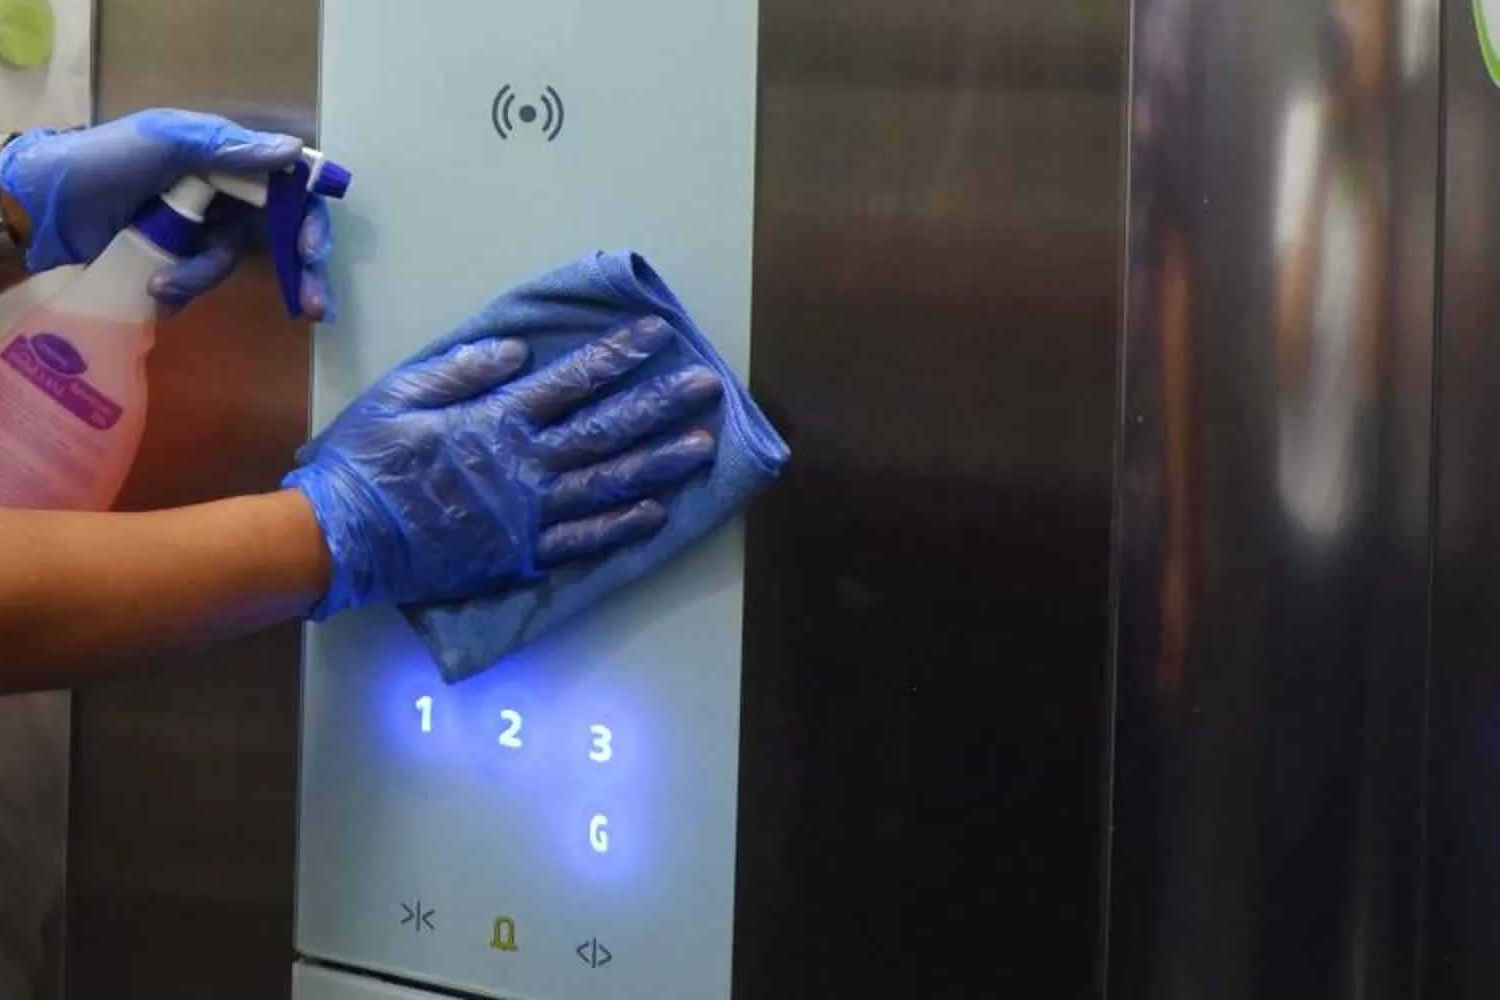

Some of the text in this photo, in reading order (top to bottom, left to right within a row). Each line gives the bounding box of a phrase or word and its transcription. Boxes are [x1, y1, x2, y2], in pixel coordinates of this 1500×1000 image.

[415, 695, 612, 762] 1 2 3
[589, 813, 609, 853] G
